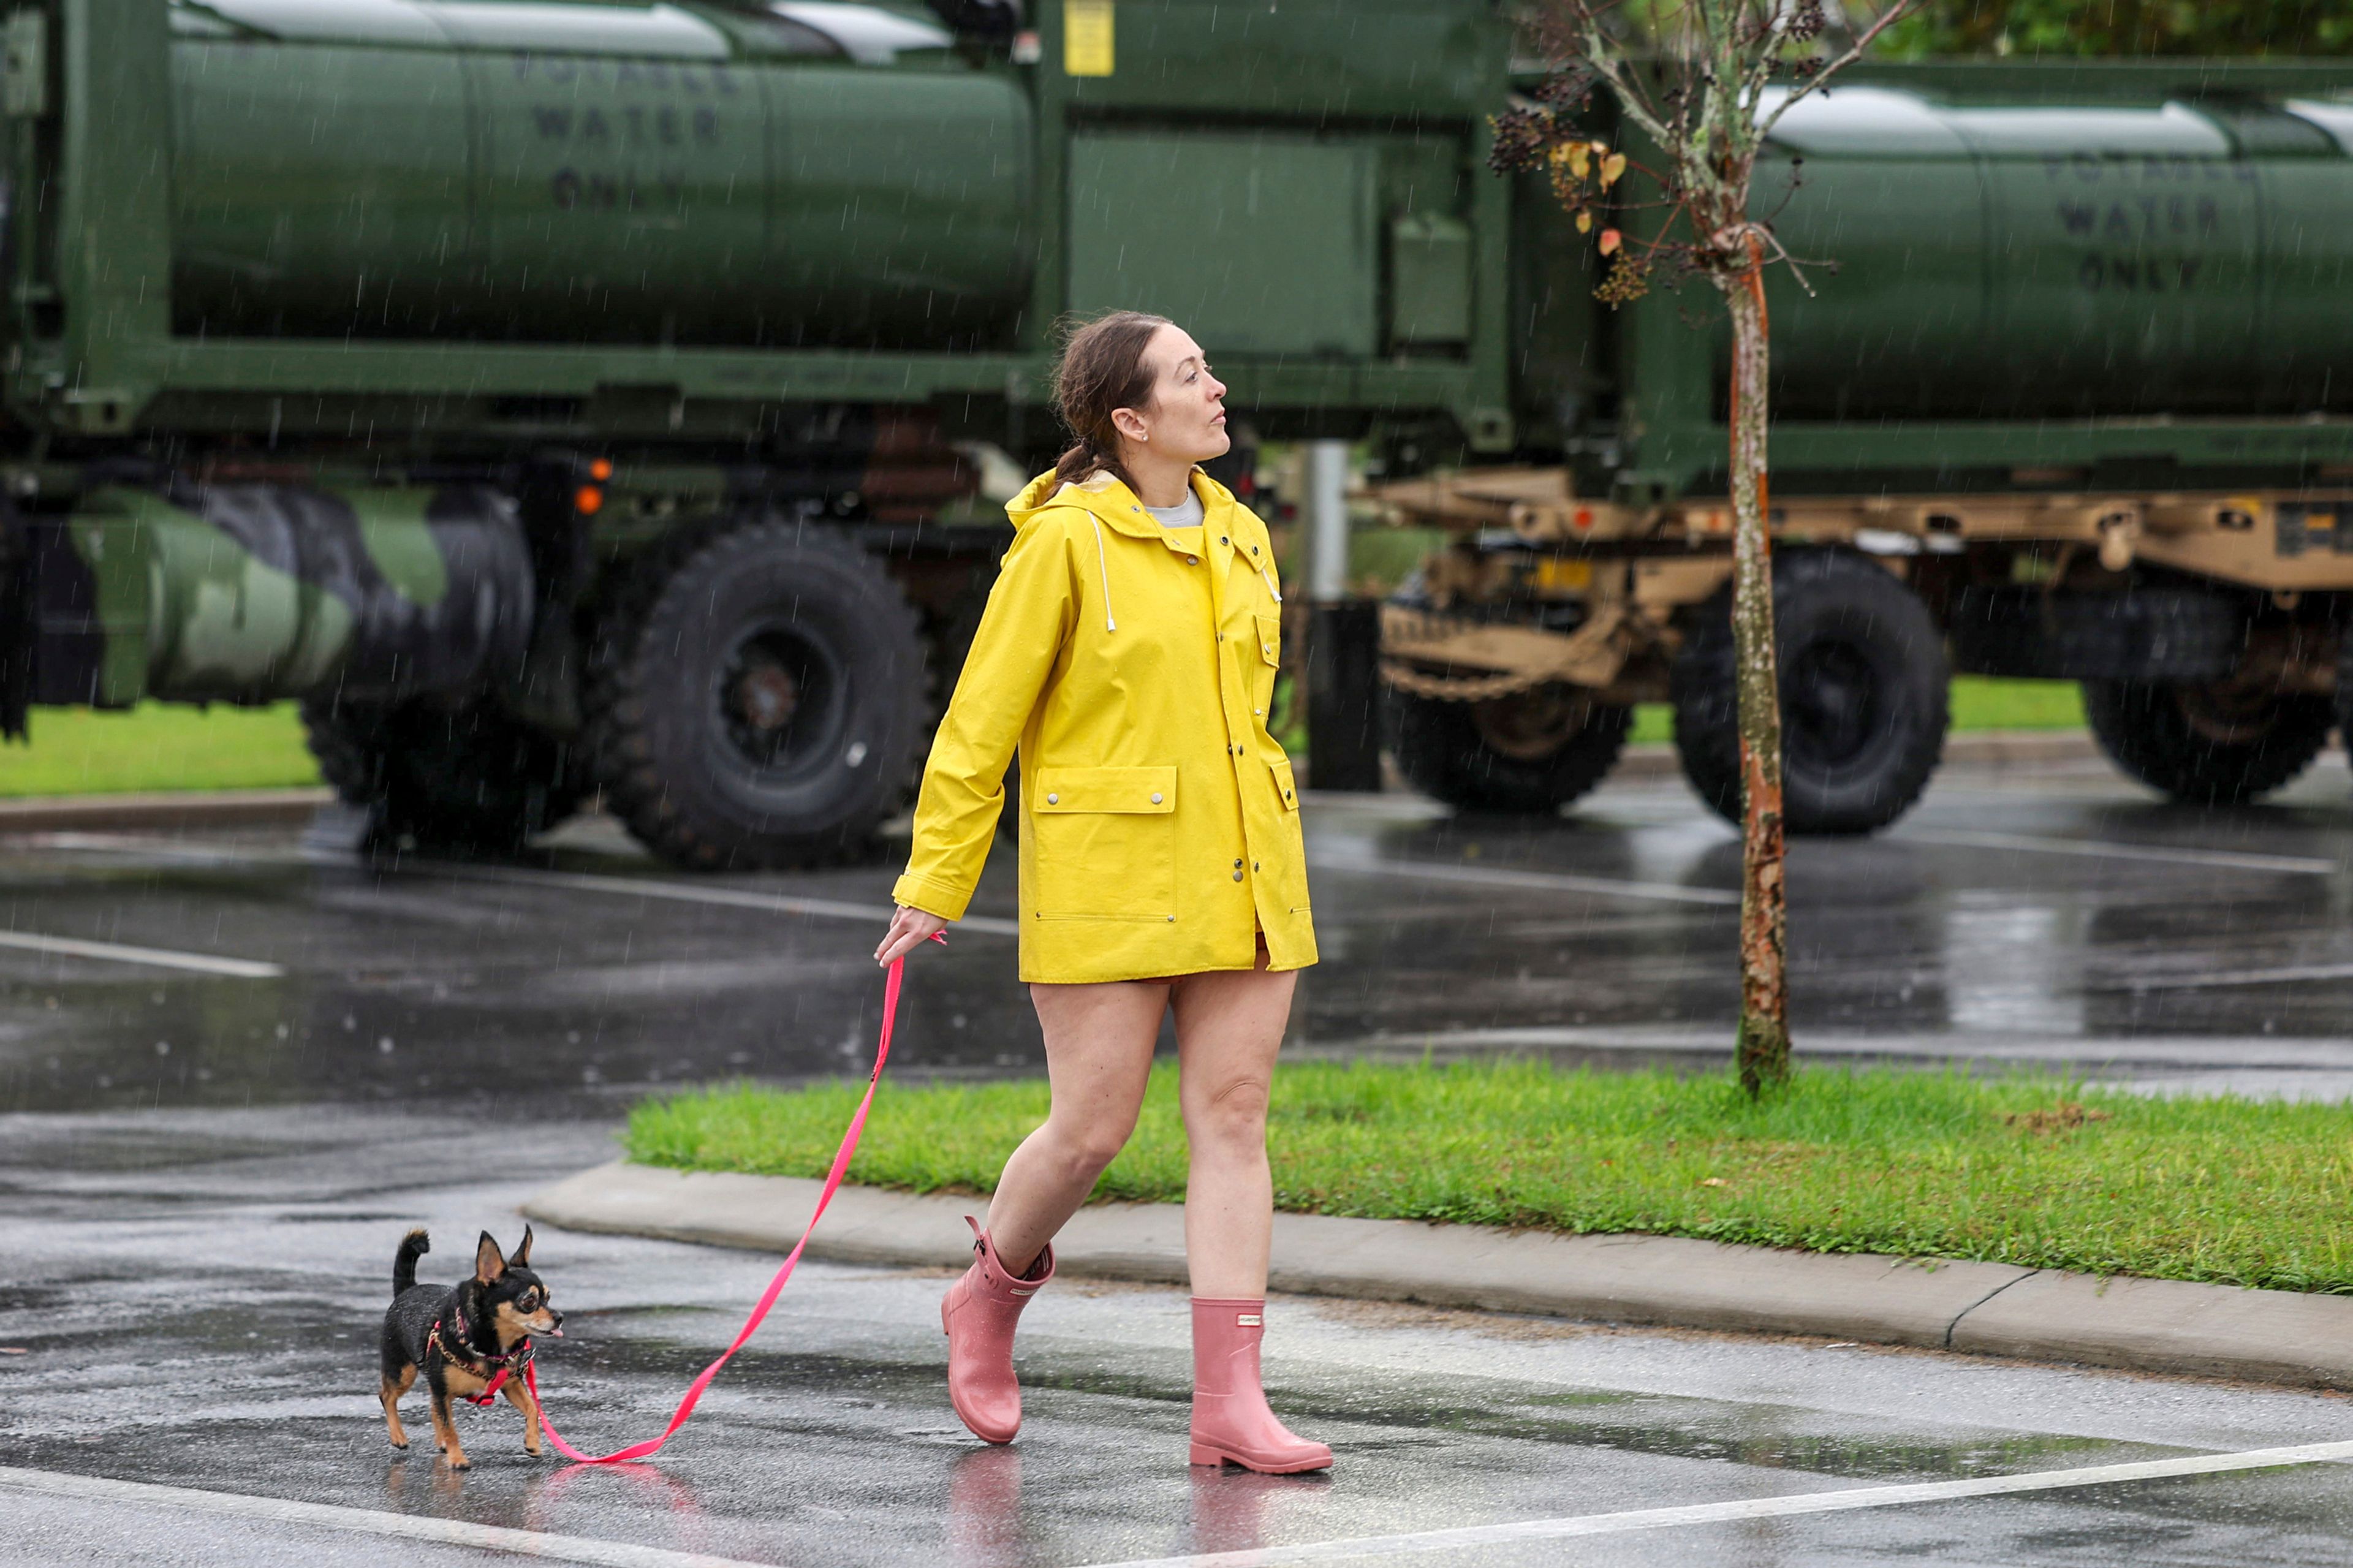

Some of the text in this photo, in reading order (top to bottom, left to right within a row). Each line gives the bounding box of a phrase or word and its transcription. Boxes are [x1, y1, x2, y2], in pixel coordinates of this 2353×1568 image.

[532, 104, 719, 146] WATER
[551, 165, 686, 210] ONLY
[2056, 194, 2217, 238] WATER
[2077, 249, 2203, 292] ONLY
